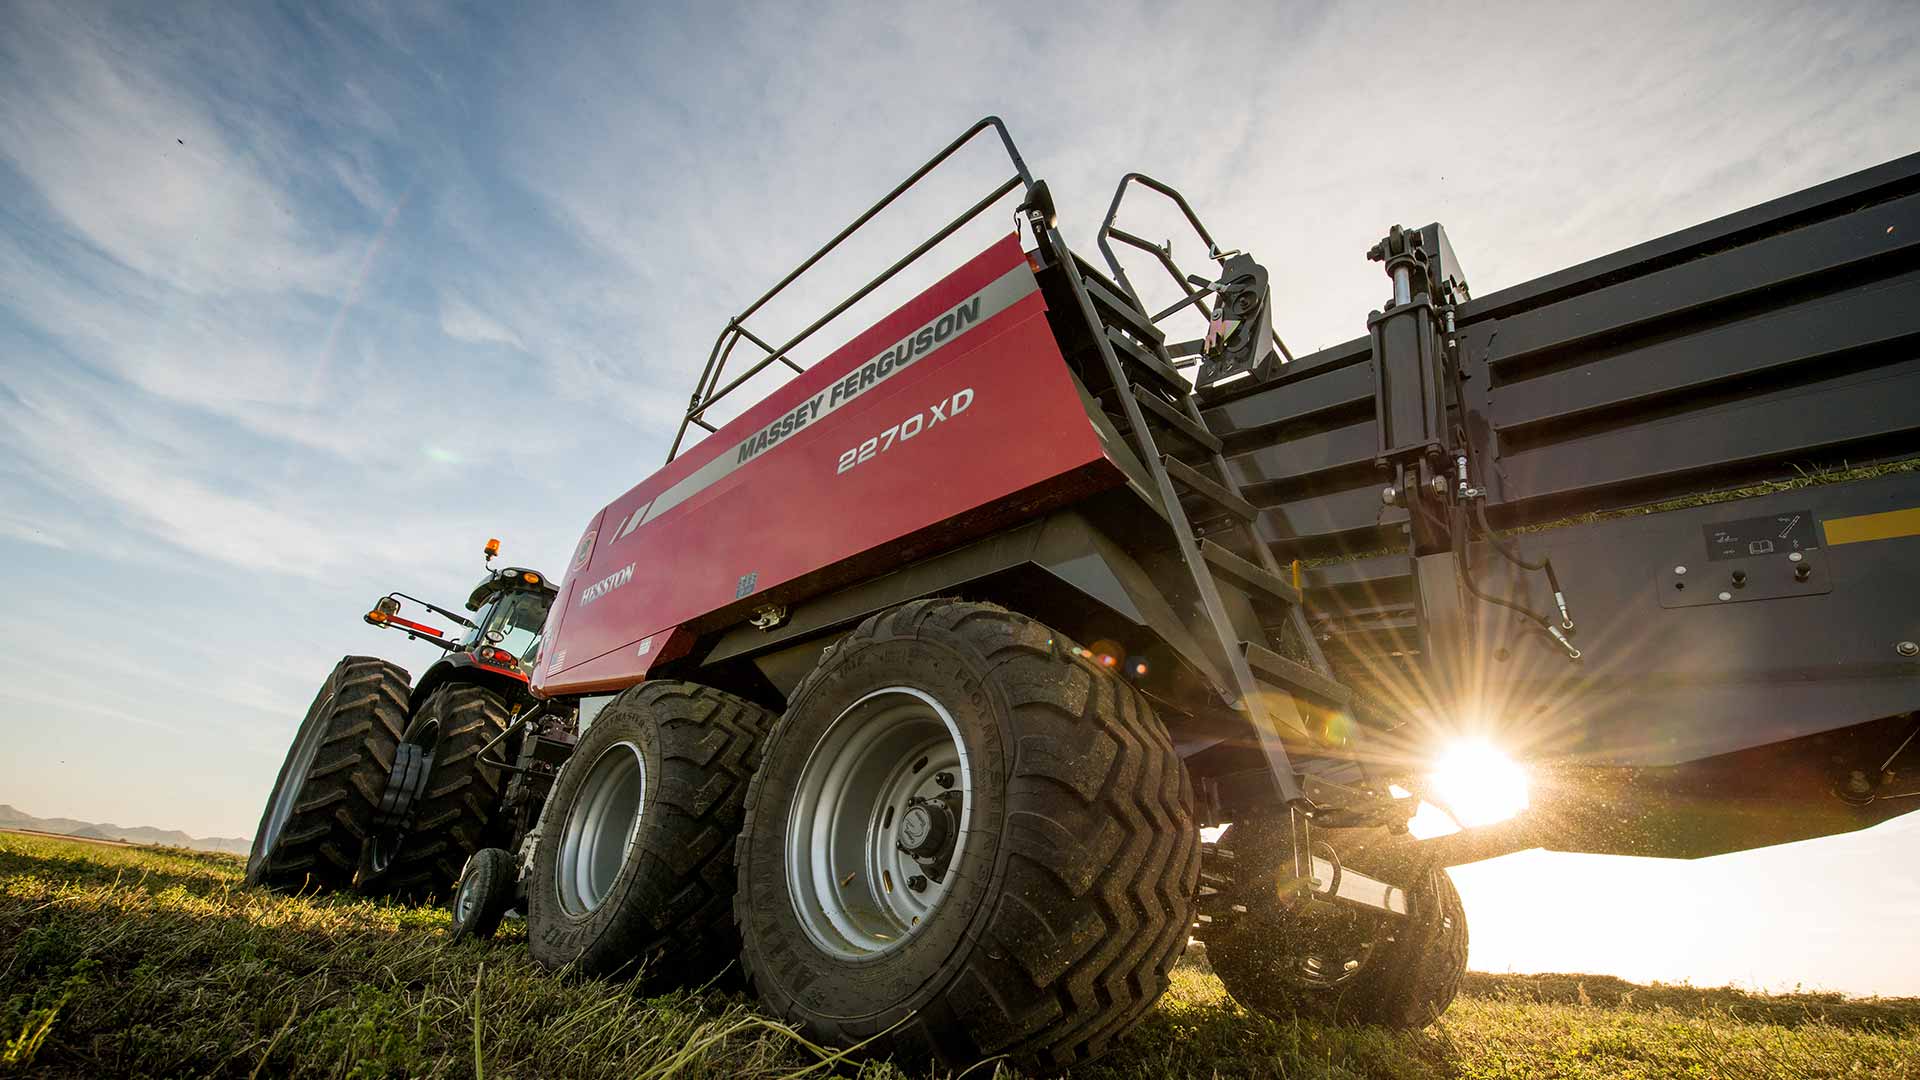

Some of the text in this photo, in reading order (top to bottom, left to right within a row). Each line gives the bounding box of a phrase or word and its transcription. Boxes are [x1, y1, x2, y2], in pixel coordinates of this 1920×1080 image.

[737, 296, 981, 465] MASSEY FERGUSON
[580, 562, 636, 607] HESSTON
